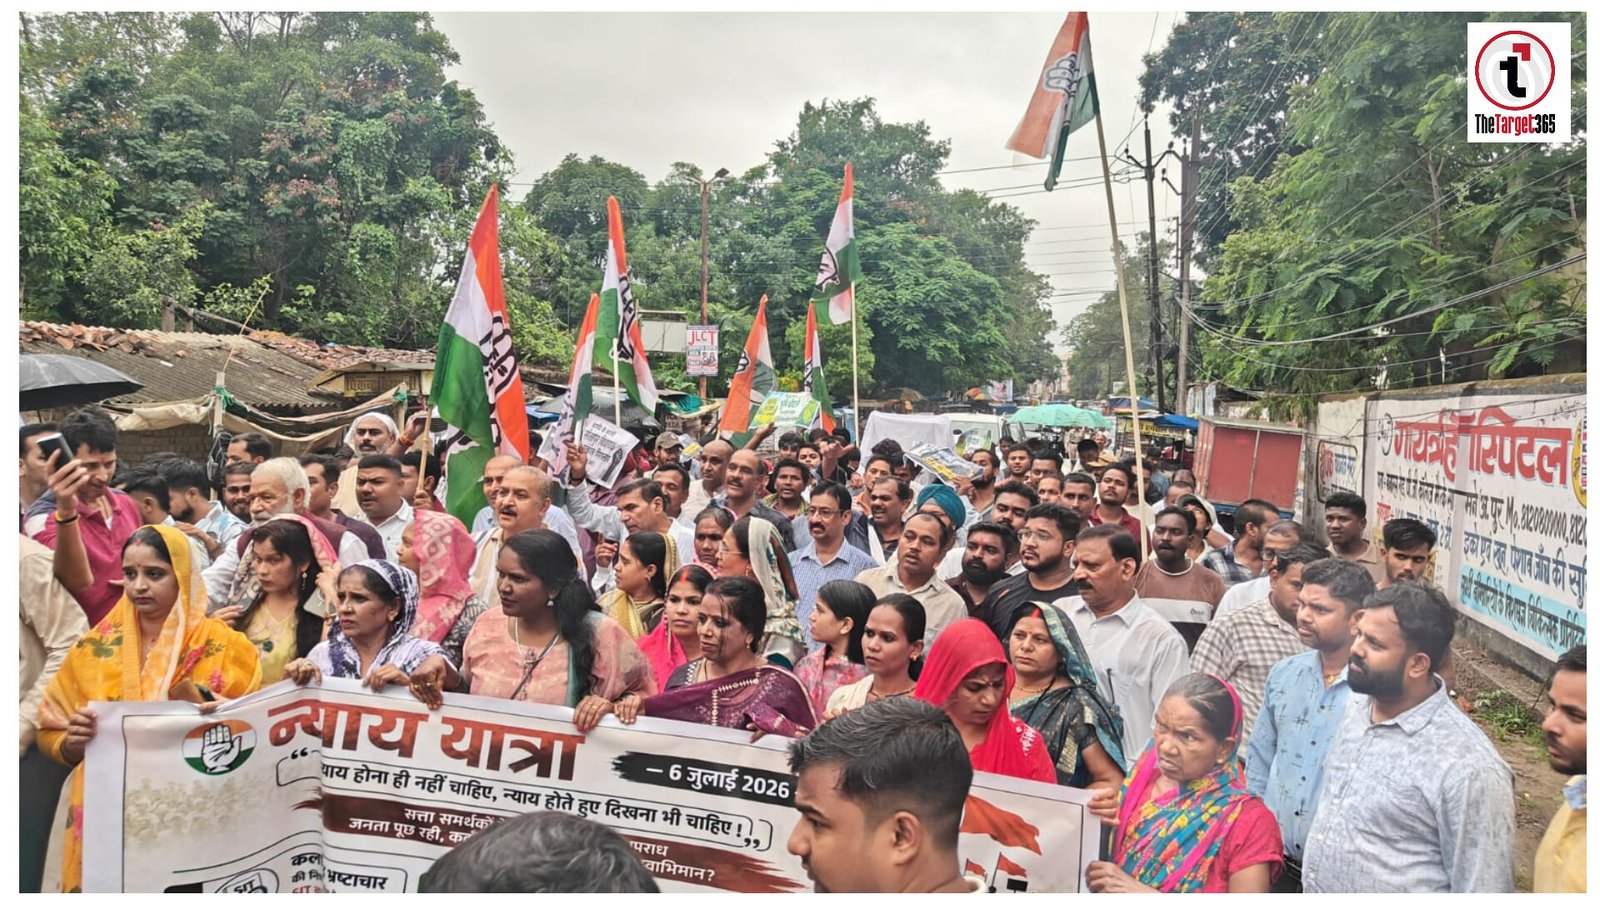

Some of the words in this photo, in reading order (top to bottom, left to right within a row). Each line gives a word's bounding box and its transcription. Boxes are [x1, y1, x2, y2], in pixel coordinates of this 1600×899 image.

[267, 699, 428, 758] न्याय
[441, 717, 586, 781] यात्रा
[321, 764, 349, 780] याय
[353, 764, 389, 785] होना
[393, 769, 410, 789] ही
[415, 771, 446, 793] नहीं
[450, 779, 497, 803] चाहिए,
[503, 788, 539, 807] न्याय
[546, 790, 573, 812] होते
[578, 798, 600, 818] हुए
[605, 797, 656, 823] दिखना
[662, 806, 682, 826] भी
[686, 814, 733, 835] चाहिए
[669, 764, 682, 781] 6
[687, 766, 739, 792] जुलाई
[742, 775, 790, 799] 2026
[349, 818, 391, 832] जनता
[394, 822, 415, 838] पूछ
[419, 825, 444, 842] रही,
[641, 860, 715, 881] वाभिमान?
[404, 808, 435, 823] सत्ता
[629, 841, 669, 857] पराध
